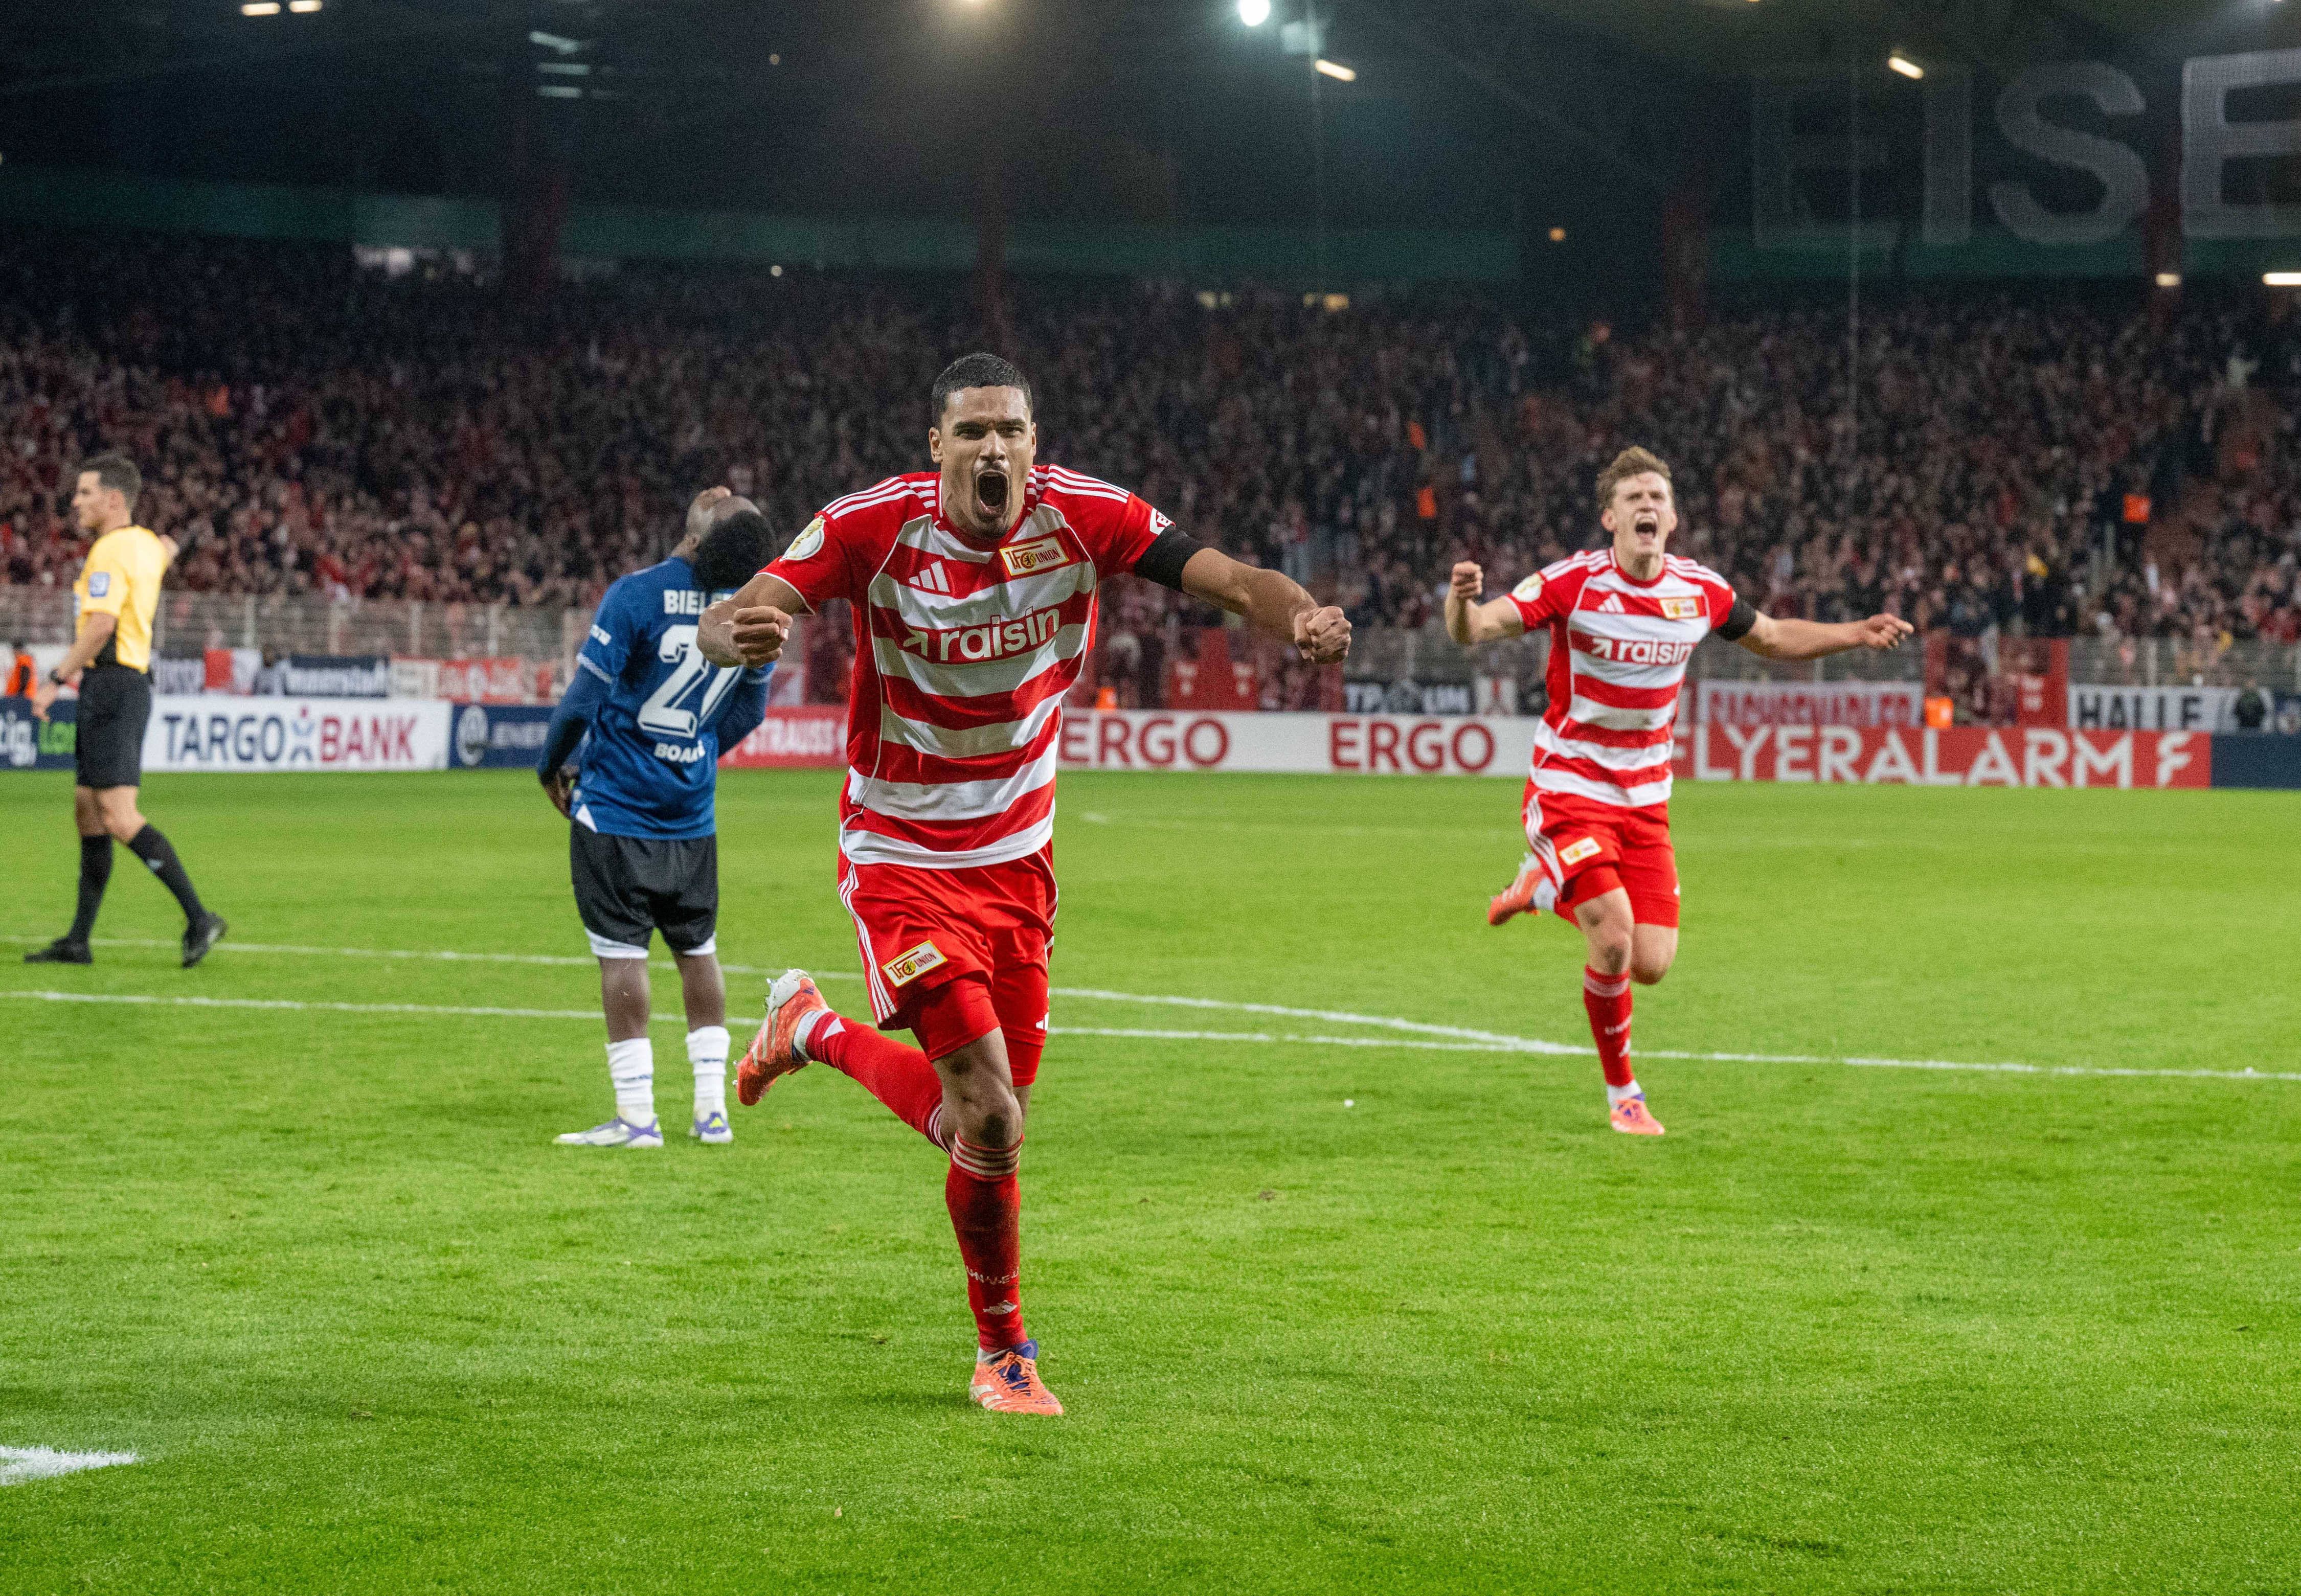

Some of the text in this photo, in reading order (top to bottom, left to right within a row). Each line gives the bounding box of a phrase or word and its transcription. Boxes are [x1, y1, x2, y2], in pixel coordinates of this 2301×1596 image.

[1035, 547, 1061, 563] UNION
[940, 606, 1060, 661] raisin
[1059, 717, 1229, 766] ERGO
[1332, 721, 1496, 773] ERGO
